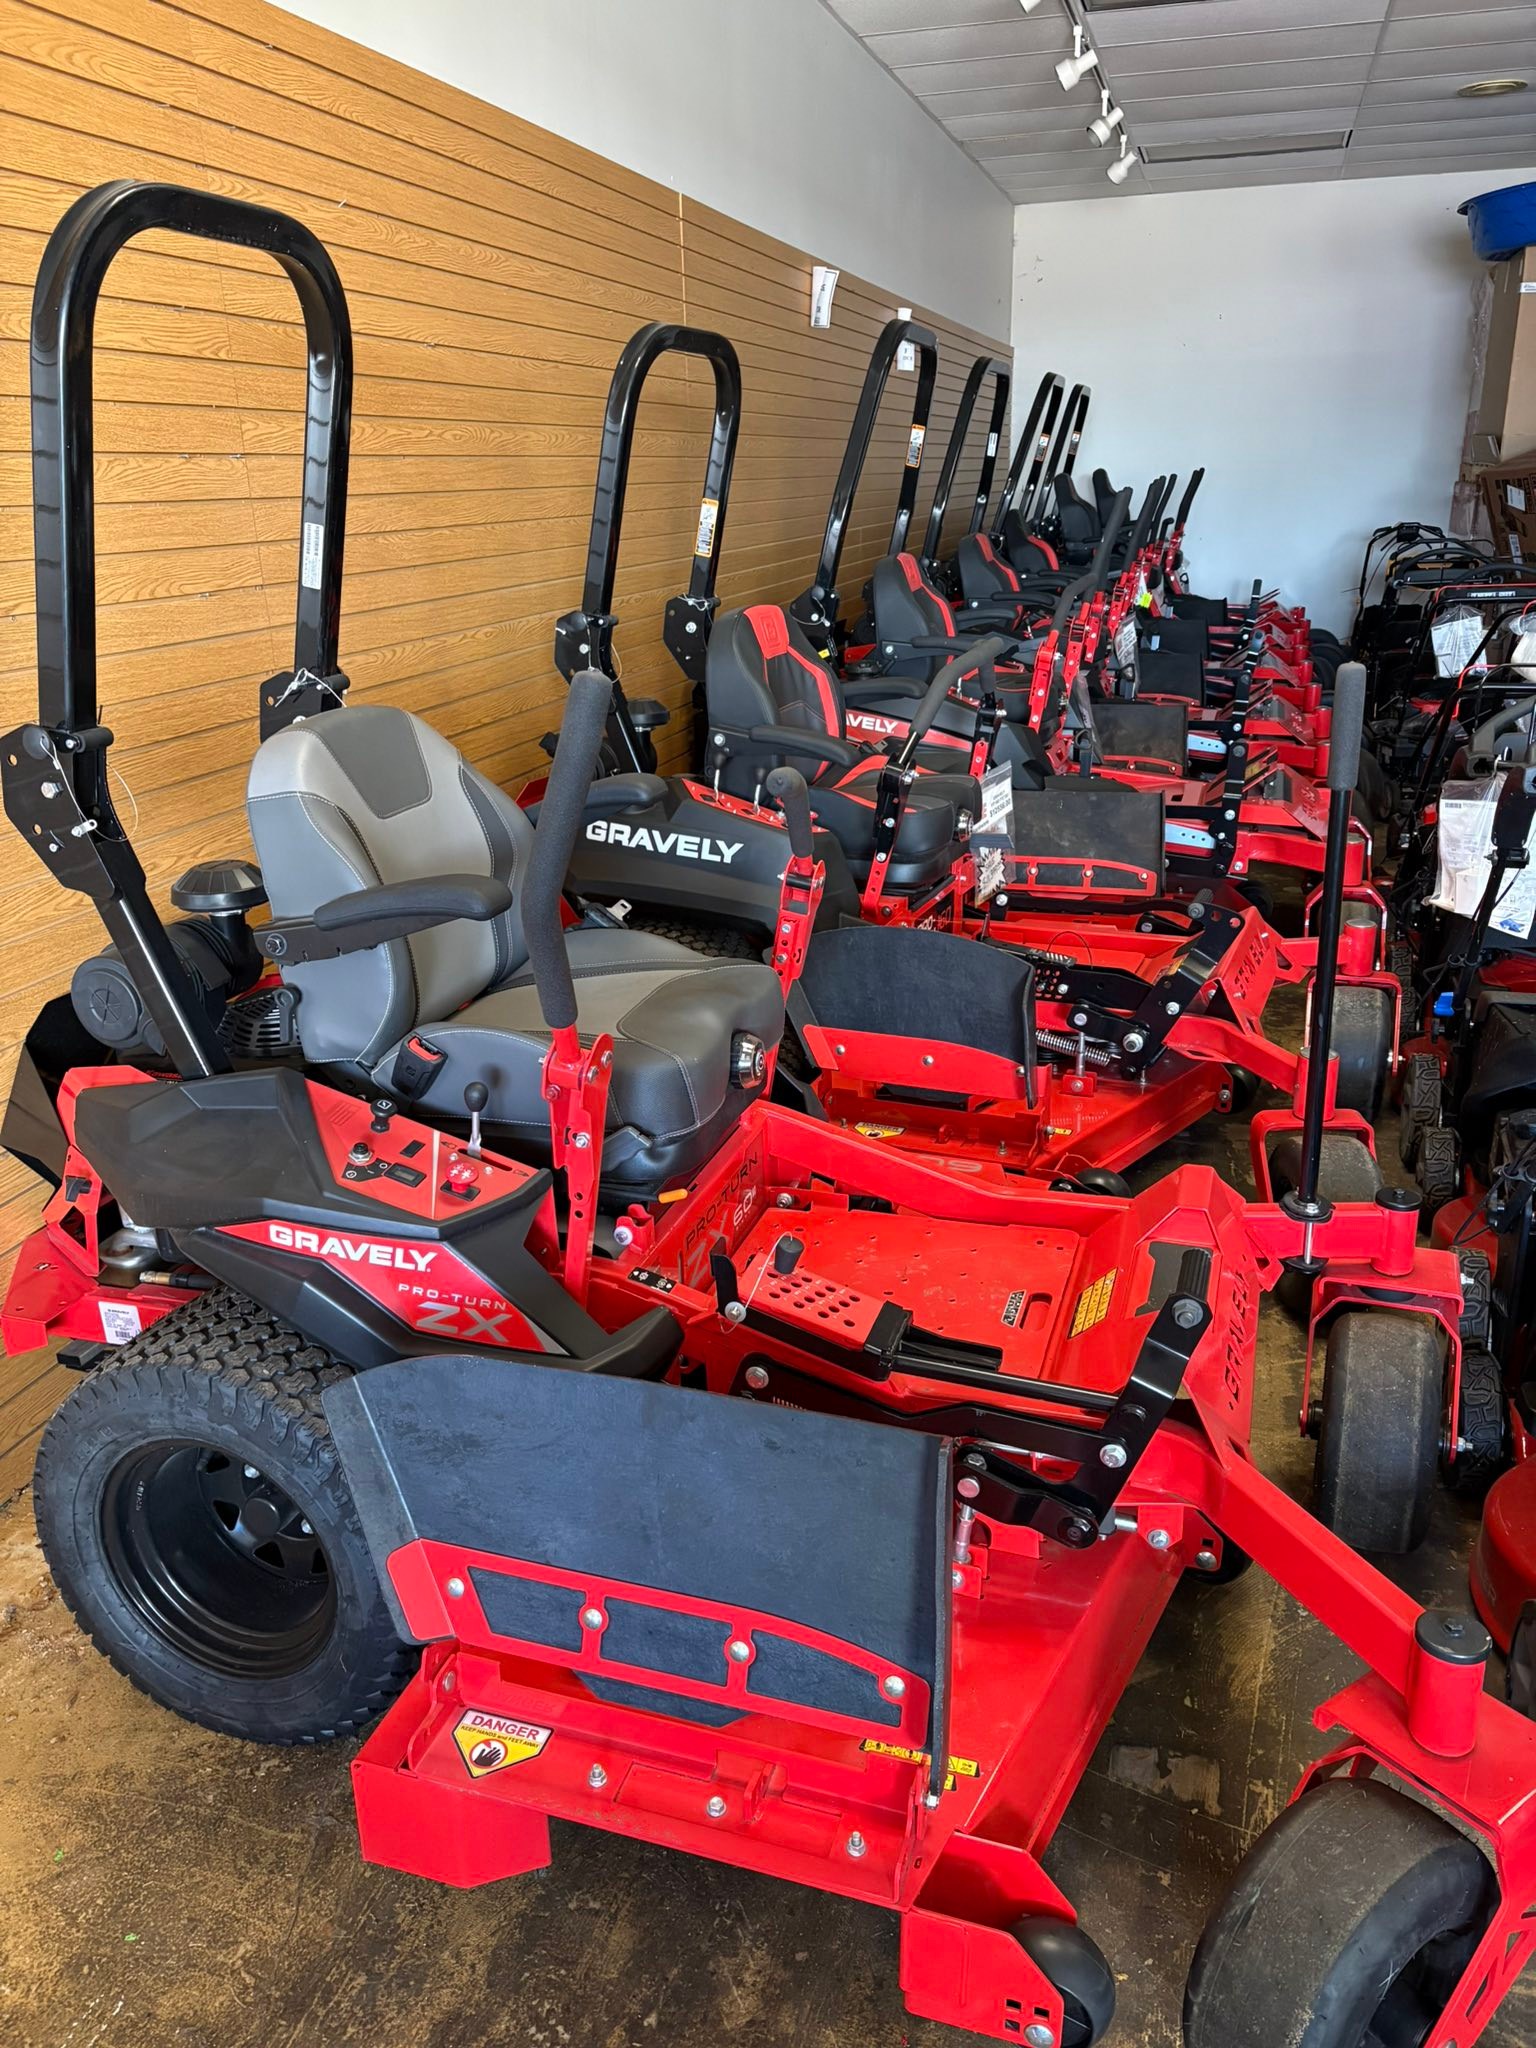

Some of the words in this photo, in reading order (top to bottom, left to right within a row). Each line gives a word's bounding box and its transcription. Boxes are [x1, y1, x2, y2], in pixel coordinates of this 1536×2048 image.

[846, 713, 898, 734] VELY
[586, 820, 744, 865] GRAVELY
[686, 1151, 758, 1251] PRO-TURN
[269, 1223, 438, 1273] GRAVELY
[397, 1282, 508, 1312] PRO-TURN
[415, 1301, 513, 1343] ZX
[471, 1715, 540, 1741] DANGER
